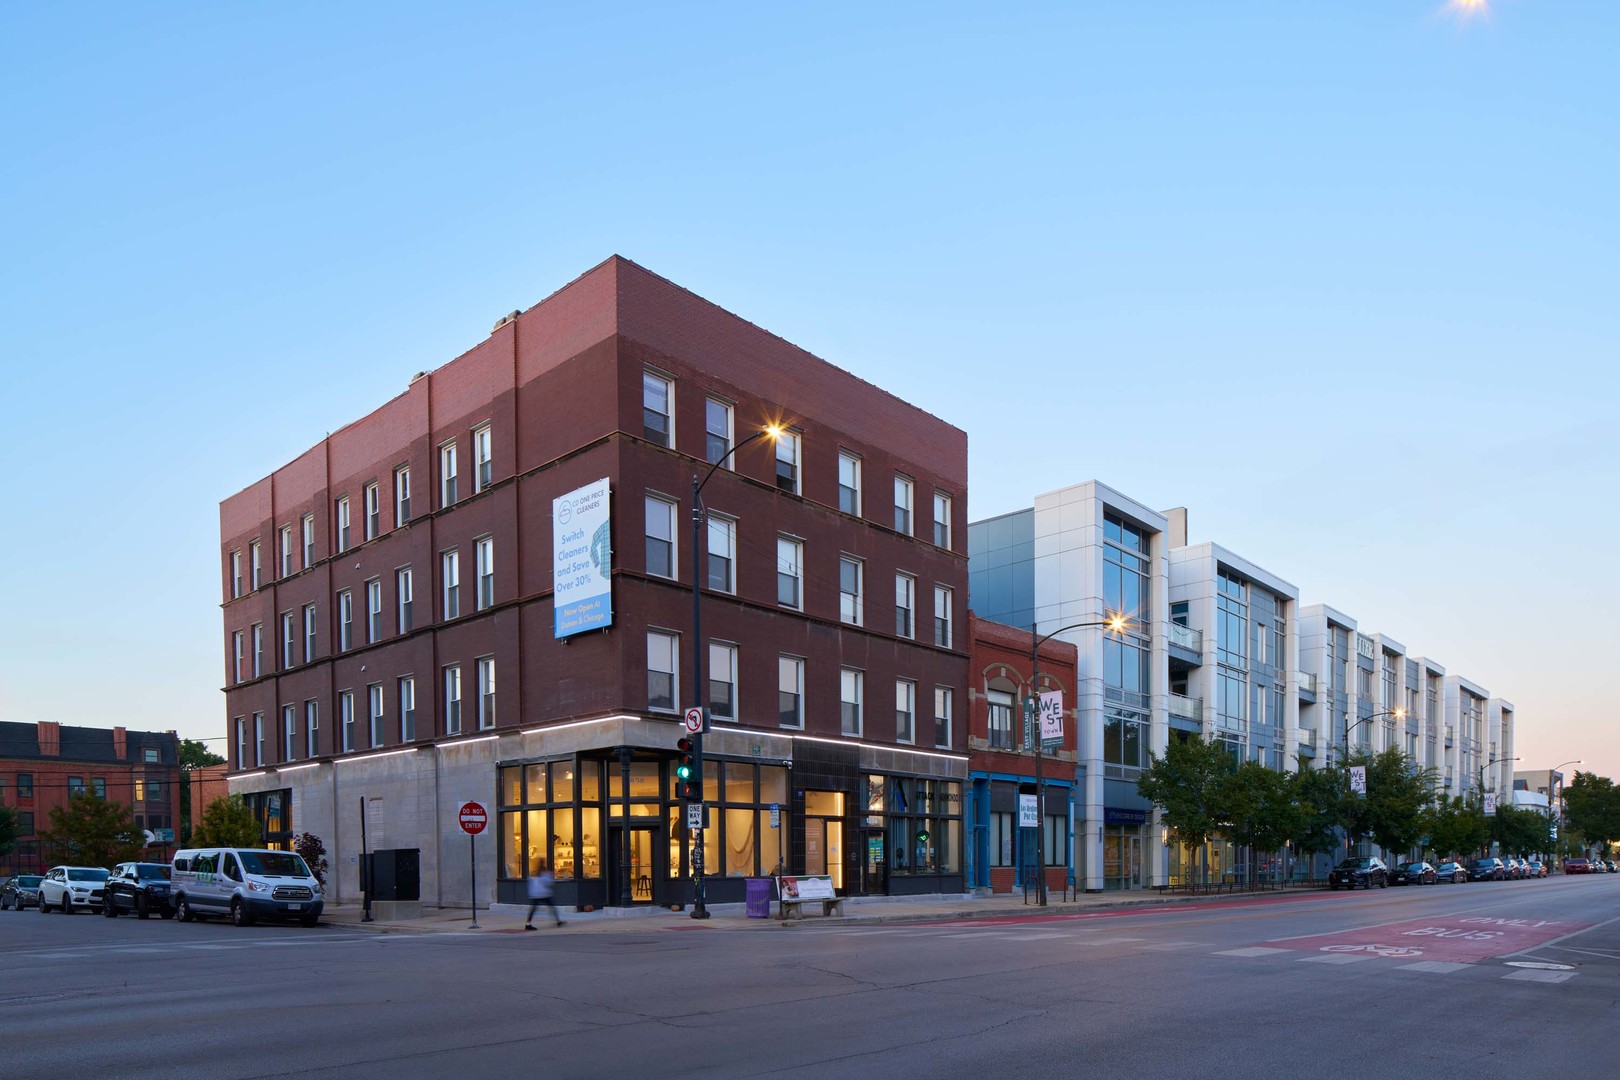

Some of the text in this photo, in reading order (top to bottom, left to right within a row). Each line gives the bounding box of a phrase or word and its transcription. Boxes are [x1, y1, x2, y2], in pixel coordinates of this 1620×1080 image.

[580, 495, 590, 504] ONE
[591, 489, 604, 500] PRICE
[577, 501, 600, 514] CLEANERS
[562, 528, 584, 544] Switch
[558, 545, 588, 561] Cleaners
[557, 560, 590, 577] and Save
[556, 574, 591, 592] Over 30%
[564, 607, 577, 617] Now
[578, 604, 593, 613] Open
[1459, 917, 1563, 928] ONLY
[1401, 927, 1504, 940] BUS
